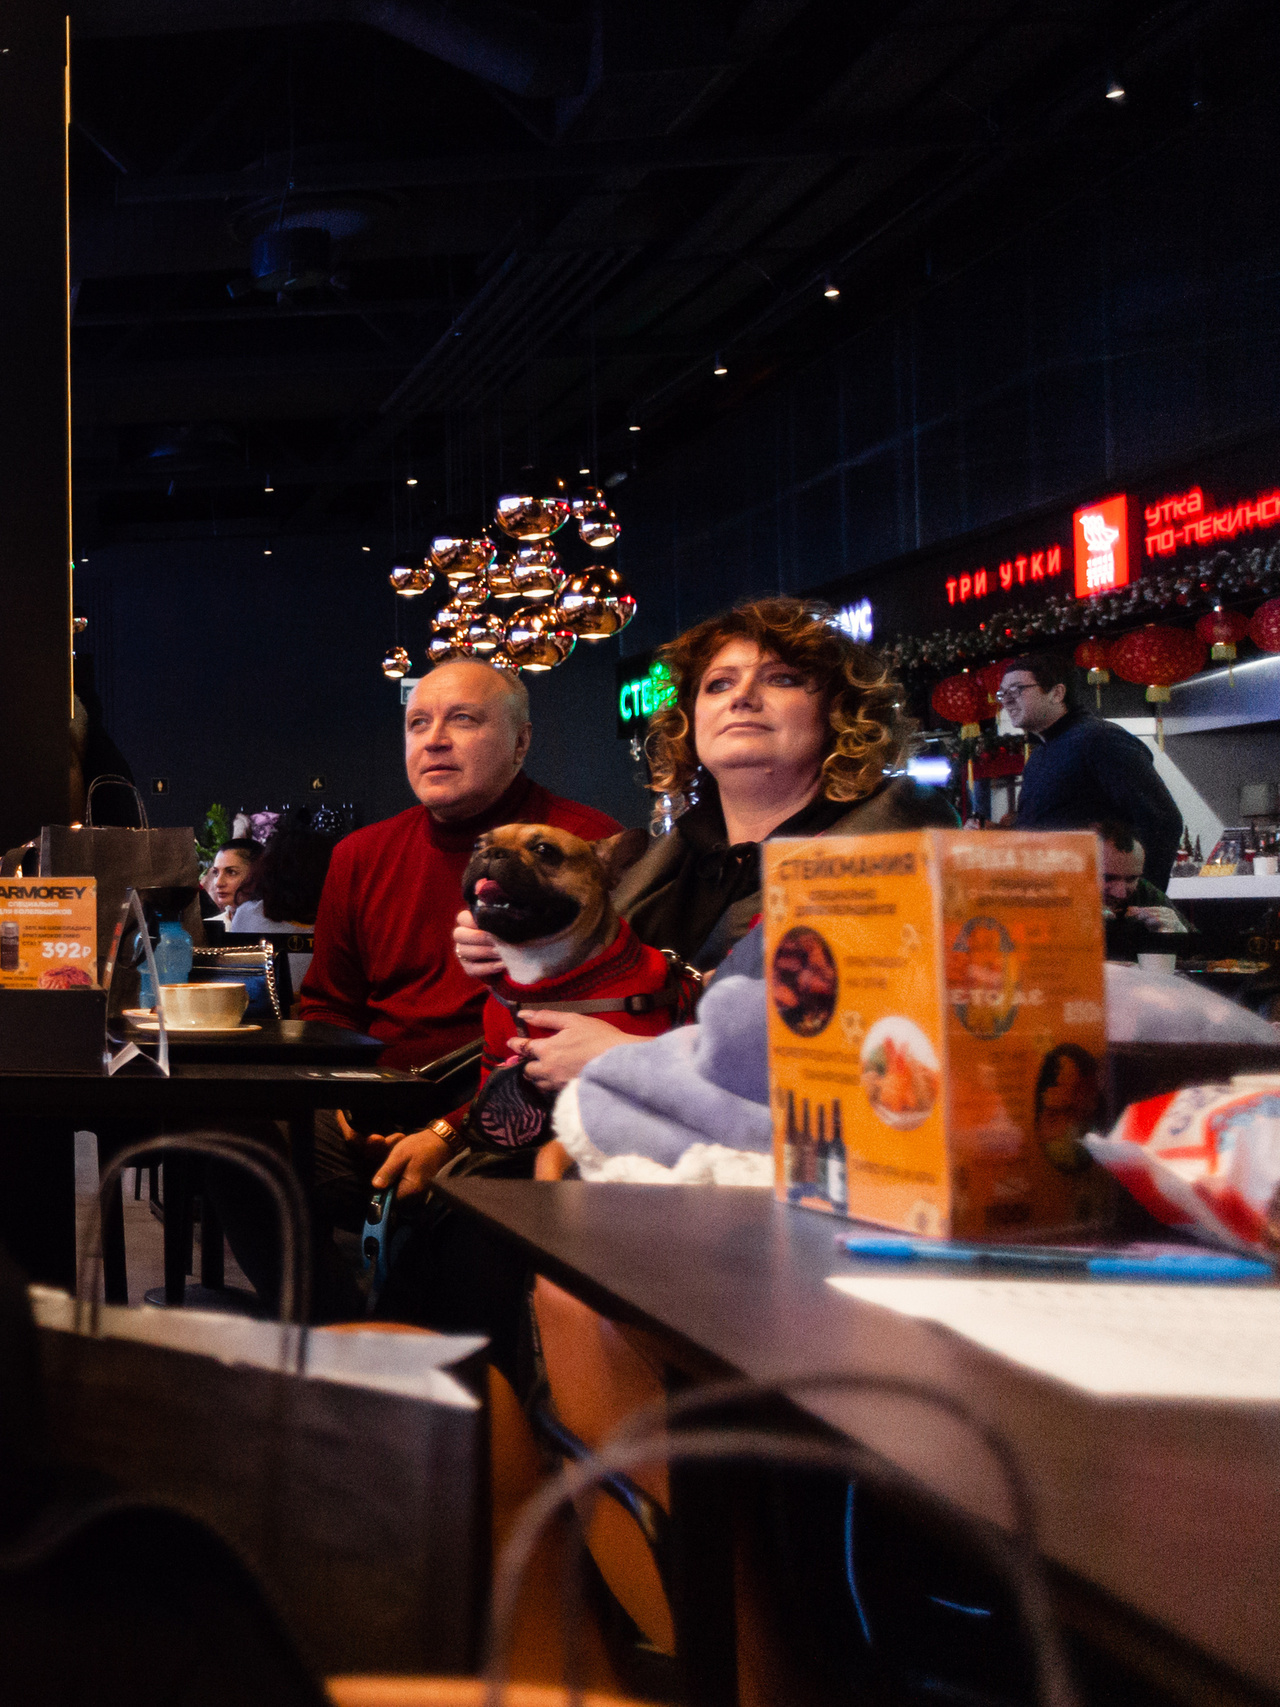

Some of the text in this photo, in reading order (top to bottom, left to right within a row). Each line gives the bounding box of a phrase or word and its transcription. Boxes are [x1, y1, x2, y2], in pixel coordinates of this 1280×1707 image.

[1145, 496, 1280, 556] ПО-ПЕКИНС
[947, 572, 988, 603] ТРИ
[1000, 547, 1061, 589] УТКИ
